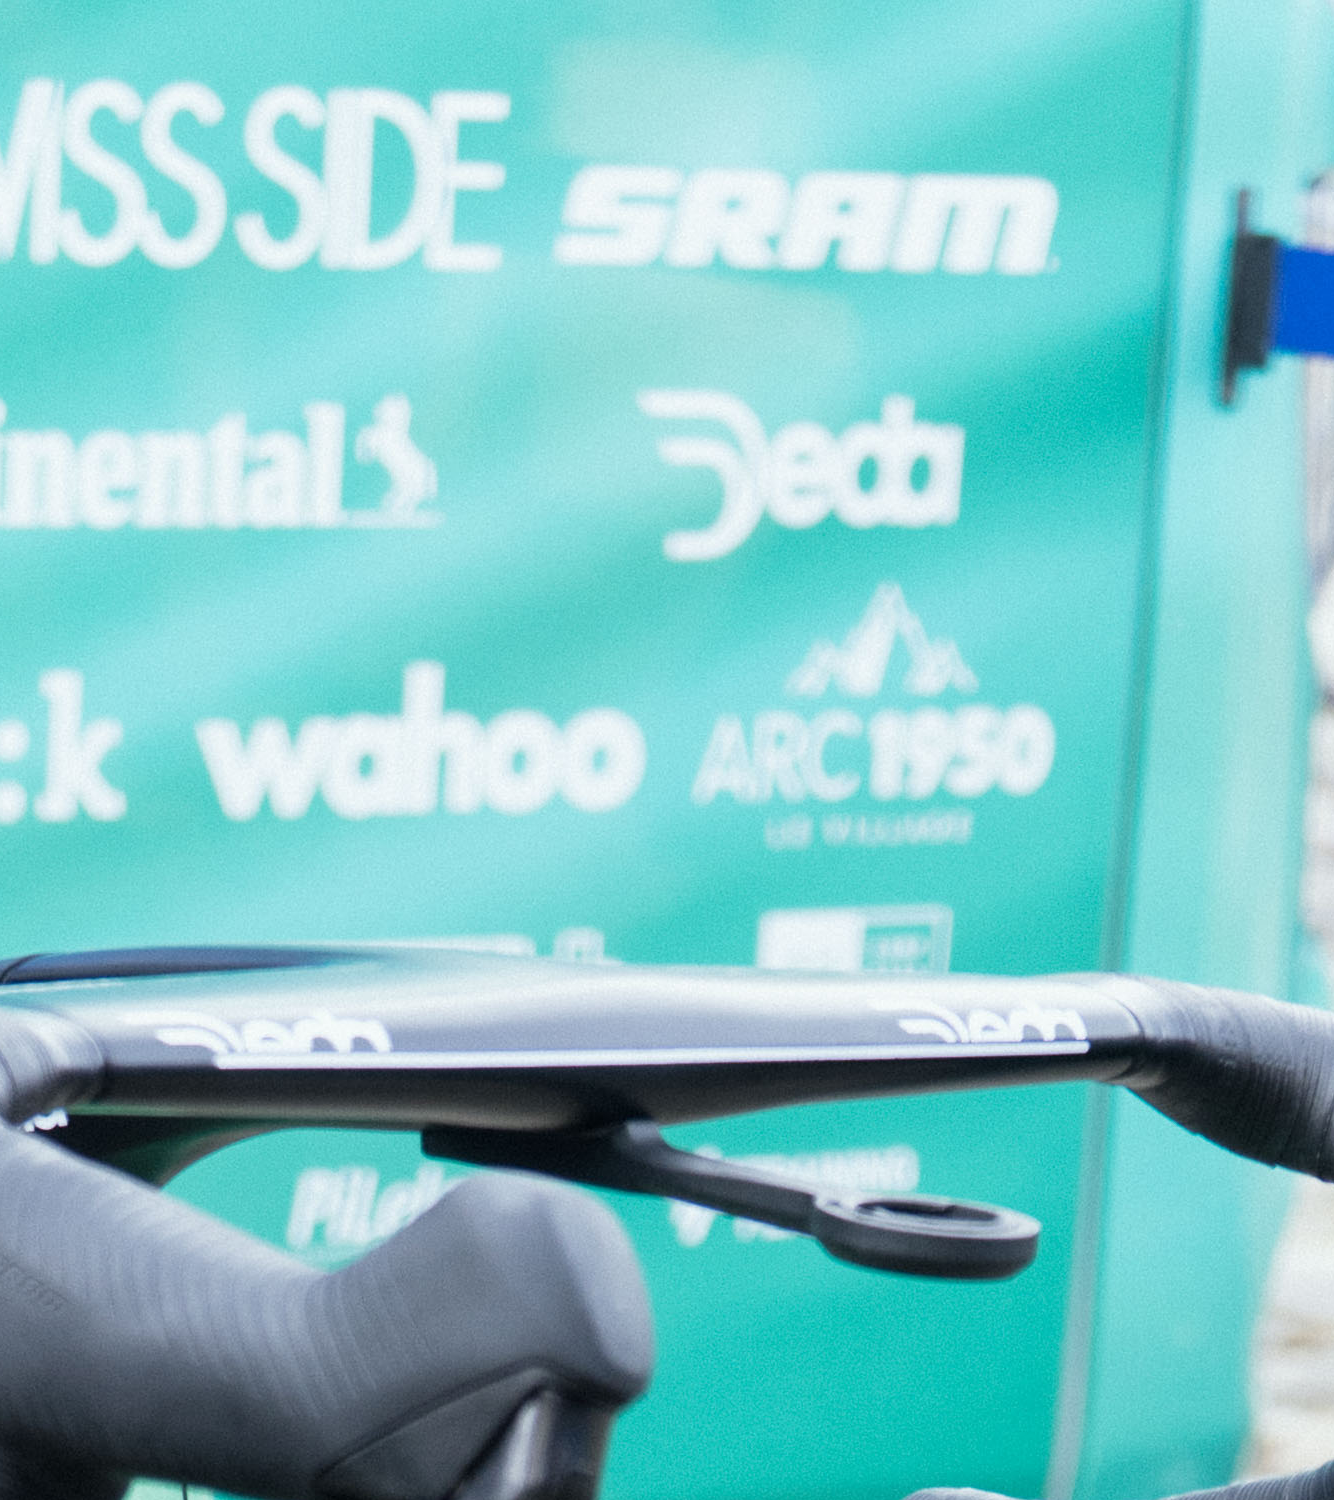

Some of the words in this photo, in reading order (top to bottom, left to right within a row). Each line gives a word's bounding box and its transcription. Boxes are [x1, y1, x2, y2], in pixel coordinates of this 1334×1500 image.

[233, 85, 511, 272] SIDE
[555, 163, 1061, 275] SRAM
[192, 660, 645, 819] wahoo
[691, 710, 864, 805] ARC
[867, 703, 1057, 800] 1950
